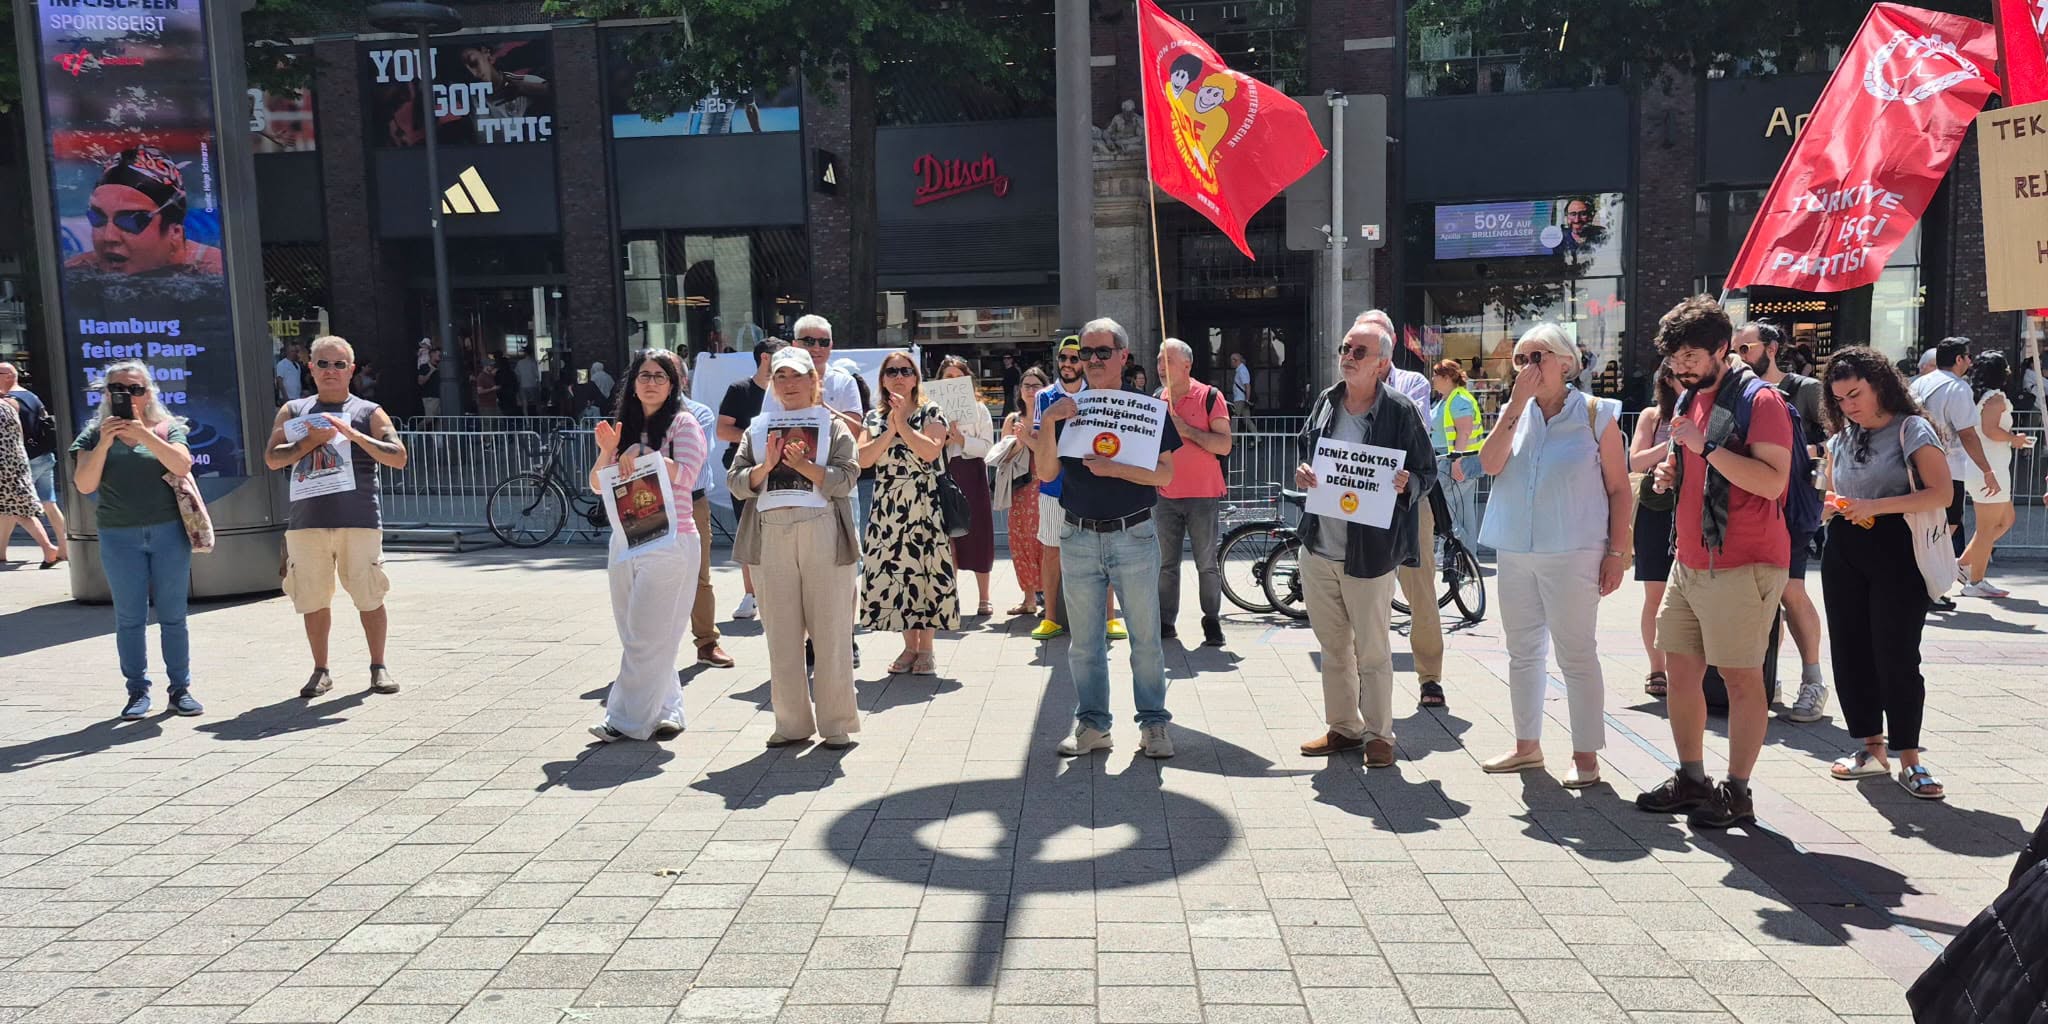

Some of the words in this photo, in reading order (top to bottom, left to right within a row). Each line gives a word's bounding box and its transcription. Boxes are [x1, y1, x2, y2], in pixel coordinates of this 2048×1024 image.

[51, 14, 166, 31] SPORTSGEIST
[369, 47, 437, 83] YOU
[432, 82, 494, 117] GOT
[1992, 114, 2046, 140] TEK
[913, 151, 998, 199] Ditsch
[1792, 180, 1904, 213] TÜRKİYE
[1474, 213, 1513, 230] 50%
[1516, 219, 1532, 228] AUF
[1837, 214, 1891, 245] İŞÇİ
[1771, 242, 1873, 277] PARTİSİ
[79, 318, 181, 337] Hamburg
[81, 341, 143, 358] feiert
[147, 342, 206, 357] Para-
[1077, 396, 1108, 405] Sanat
[1111, 397, 1125, 406] ve
[1127, 398, 1158, 413] ifade
[1076, 406, 1158, 425] zgürlüğünden
[1069, 418, 1118, 430] ellerinizi
[1120, 421, 1156, 437] çekin!
[1318, 447, 1349, 460] DENİZ
[1350, 450, 1398, 471] GÖKTAŞ
[1335, 463, 1376, 478] YALNIZ
[1326, 474, 1380, 492] DEĞİLDİR!
